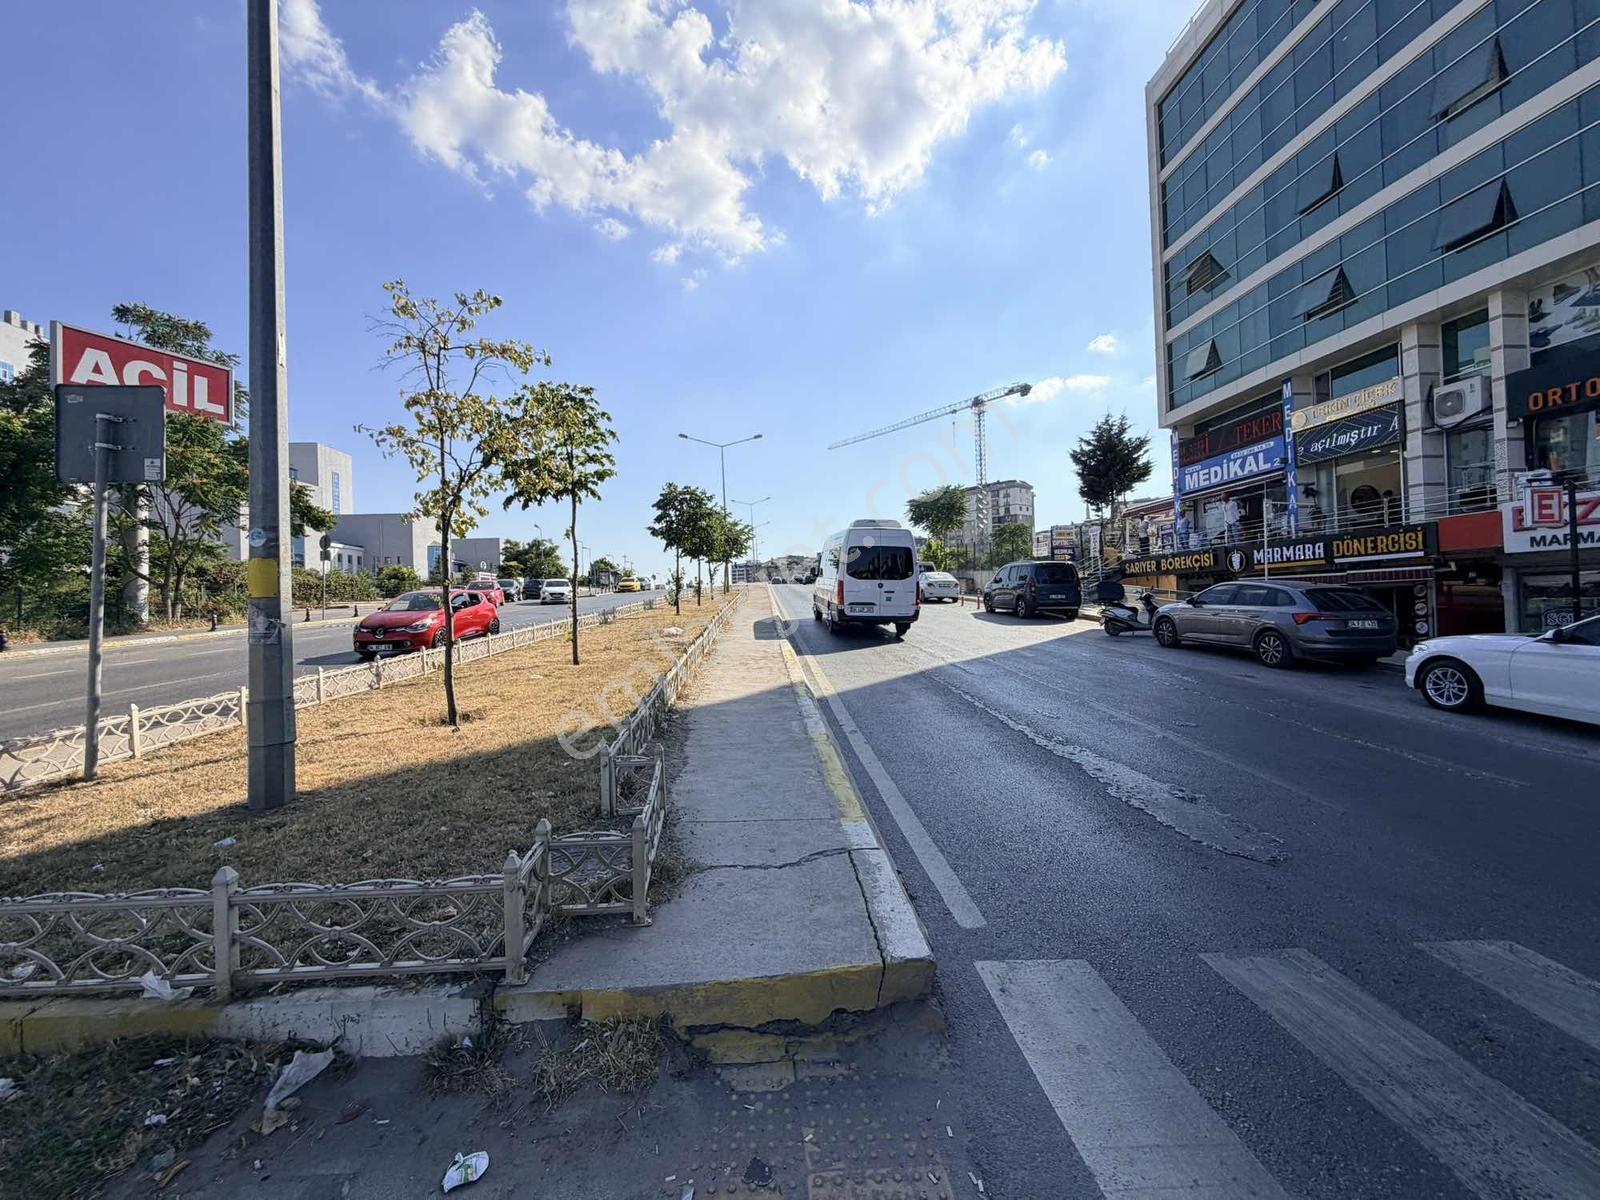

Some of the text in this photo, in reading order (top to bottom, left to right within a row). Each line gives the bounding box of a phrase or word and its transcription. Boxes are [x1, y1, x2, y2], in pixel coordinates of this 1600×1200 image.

[1528, 377, 1600, 411] ORTO
[1310, 424, 1382, 452] açılmıştır
[1185, 452, 1271, 490] MEDİKAL
[1253, 527, 1424, 564] MARMARA DÖNERCİSİ
[1530, 531, 1600, 548] MARM
[1125, 558, 1157, 574] SARIYER
